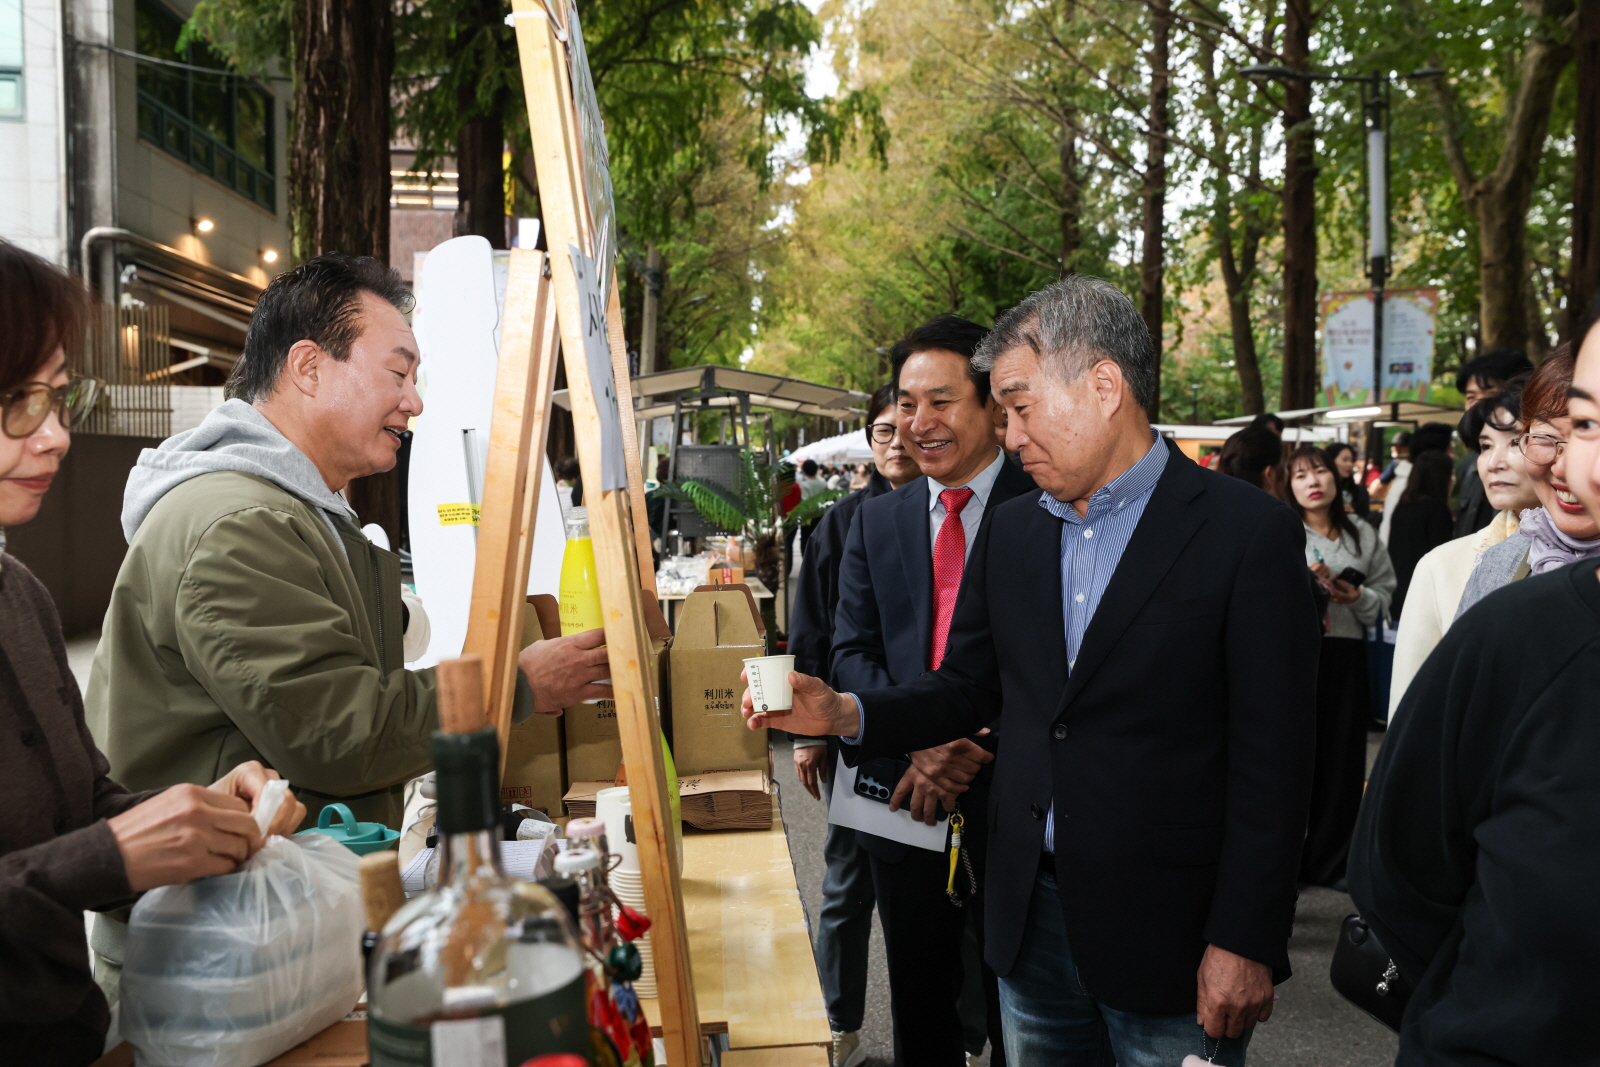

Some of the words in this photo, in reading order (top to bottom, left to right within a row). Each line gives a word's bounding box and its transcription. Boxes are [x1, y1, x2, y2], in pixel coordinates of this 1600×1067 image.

[704, 688, 734, 700] 利川米
[596, 700, 616, 709] 利川
